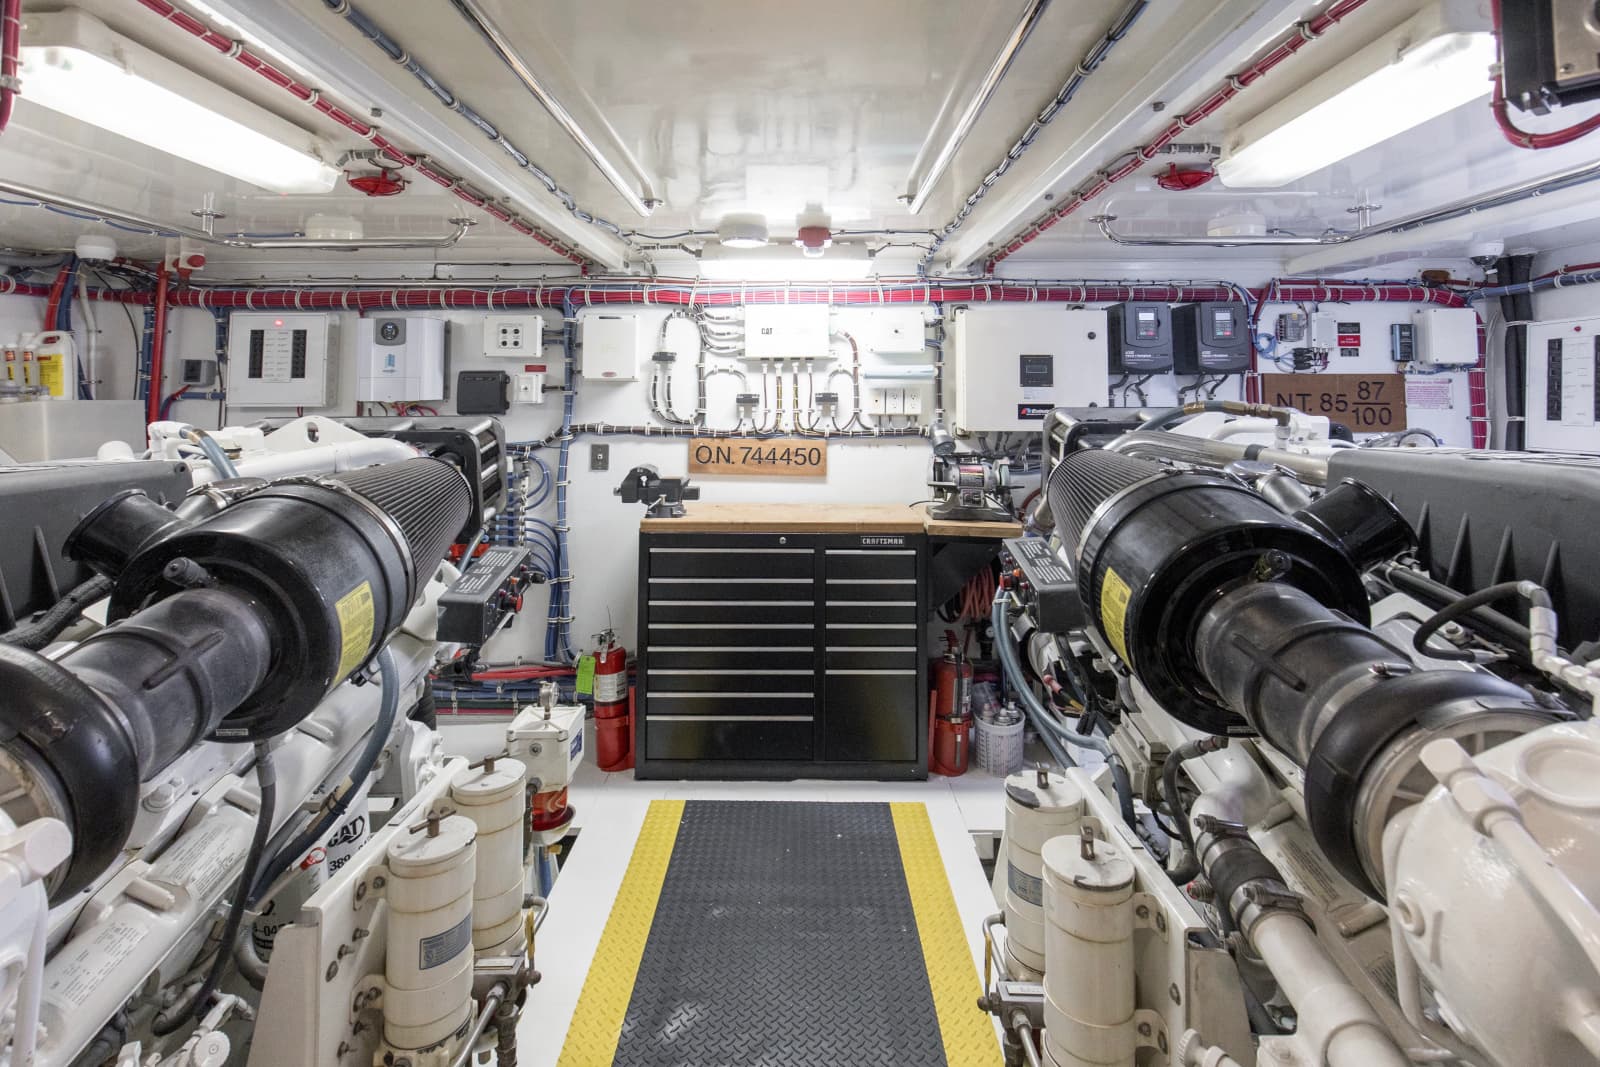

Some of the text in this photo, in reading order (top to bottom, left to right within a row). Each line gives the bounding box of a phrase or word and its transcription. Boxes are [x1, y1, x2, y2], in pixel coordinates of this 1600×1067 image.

[1357, 381, 1385, 401] 87
[1319, 392, 1348, 412] 85
[1352, 407, 1392, 426] 100
[695, 445, 821, 466] O.N. 744450
[862, 537, 903, 545] CRAFTSMAN
[327, 818, 359, 848] CAT
